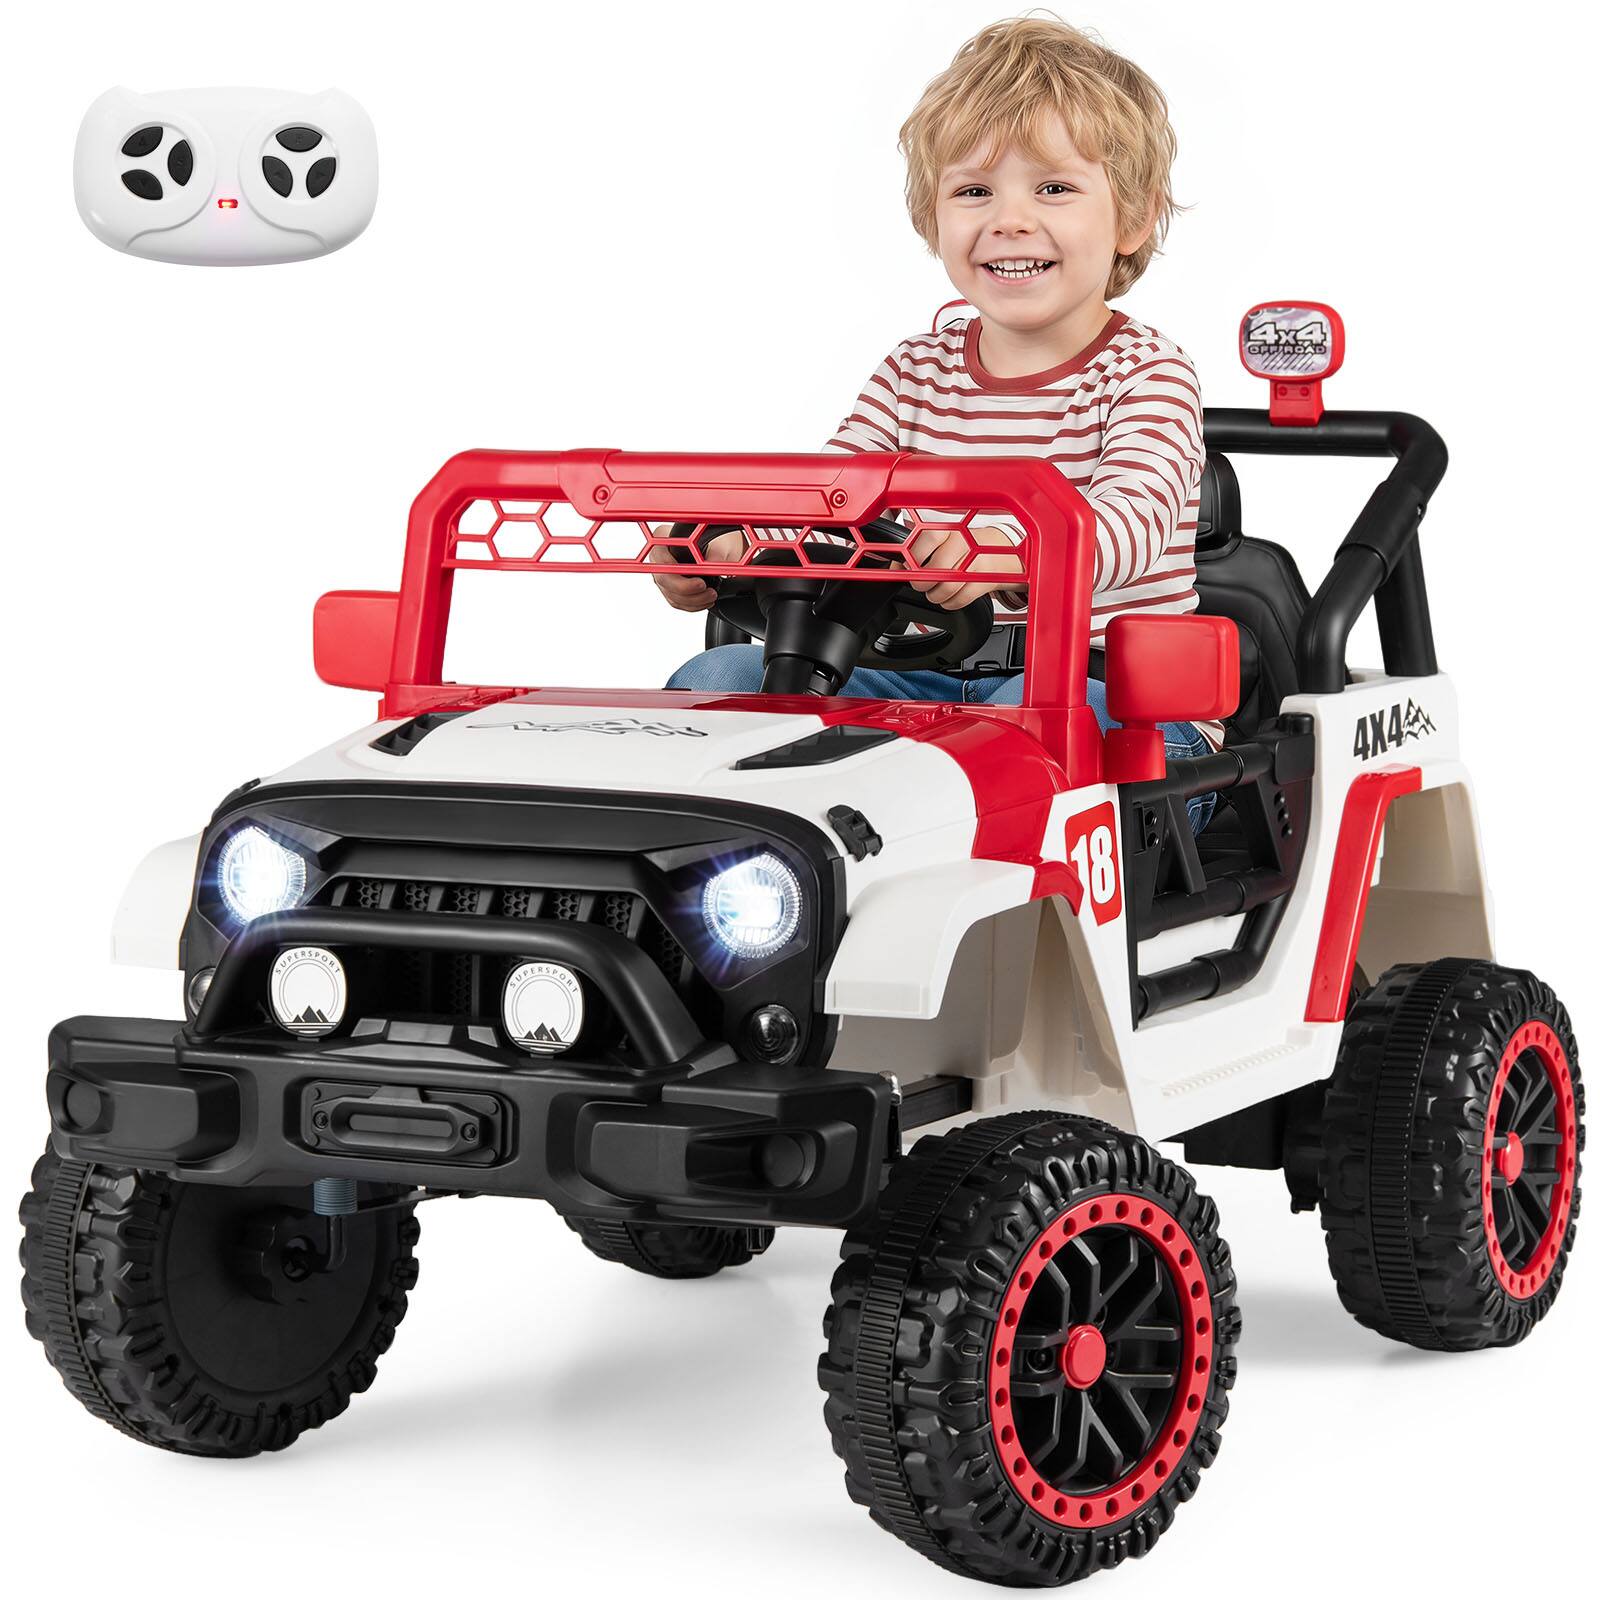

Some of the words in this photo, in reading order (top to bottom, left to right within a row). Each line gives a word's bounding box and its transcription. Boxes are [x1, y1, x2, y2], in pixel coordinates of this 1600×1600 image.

[1353, 703, 1404, 761] 4X4
[1070, 825, 1116, 904] 18
[275, 950, 341, 975] SUPERSPORT
[510, 966, 579, 993] SUPERSPORT
